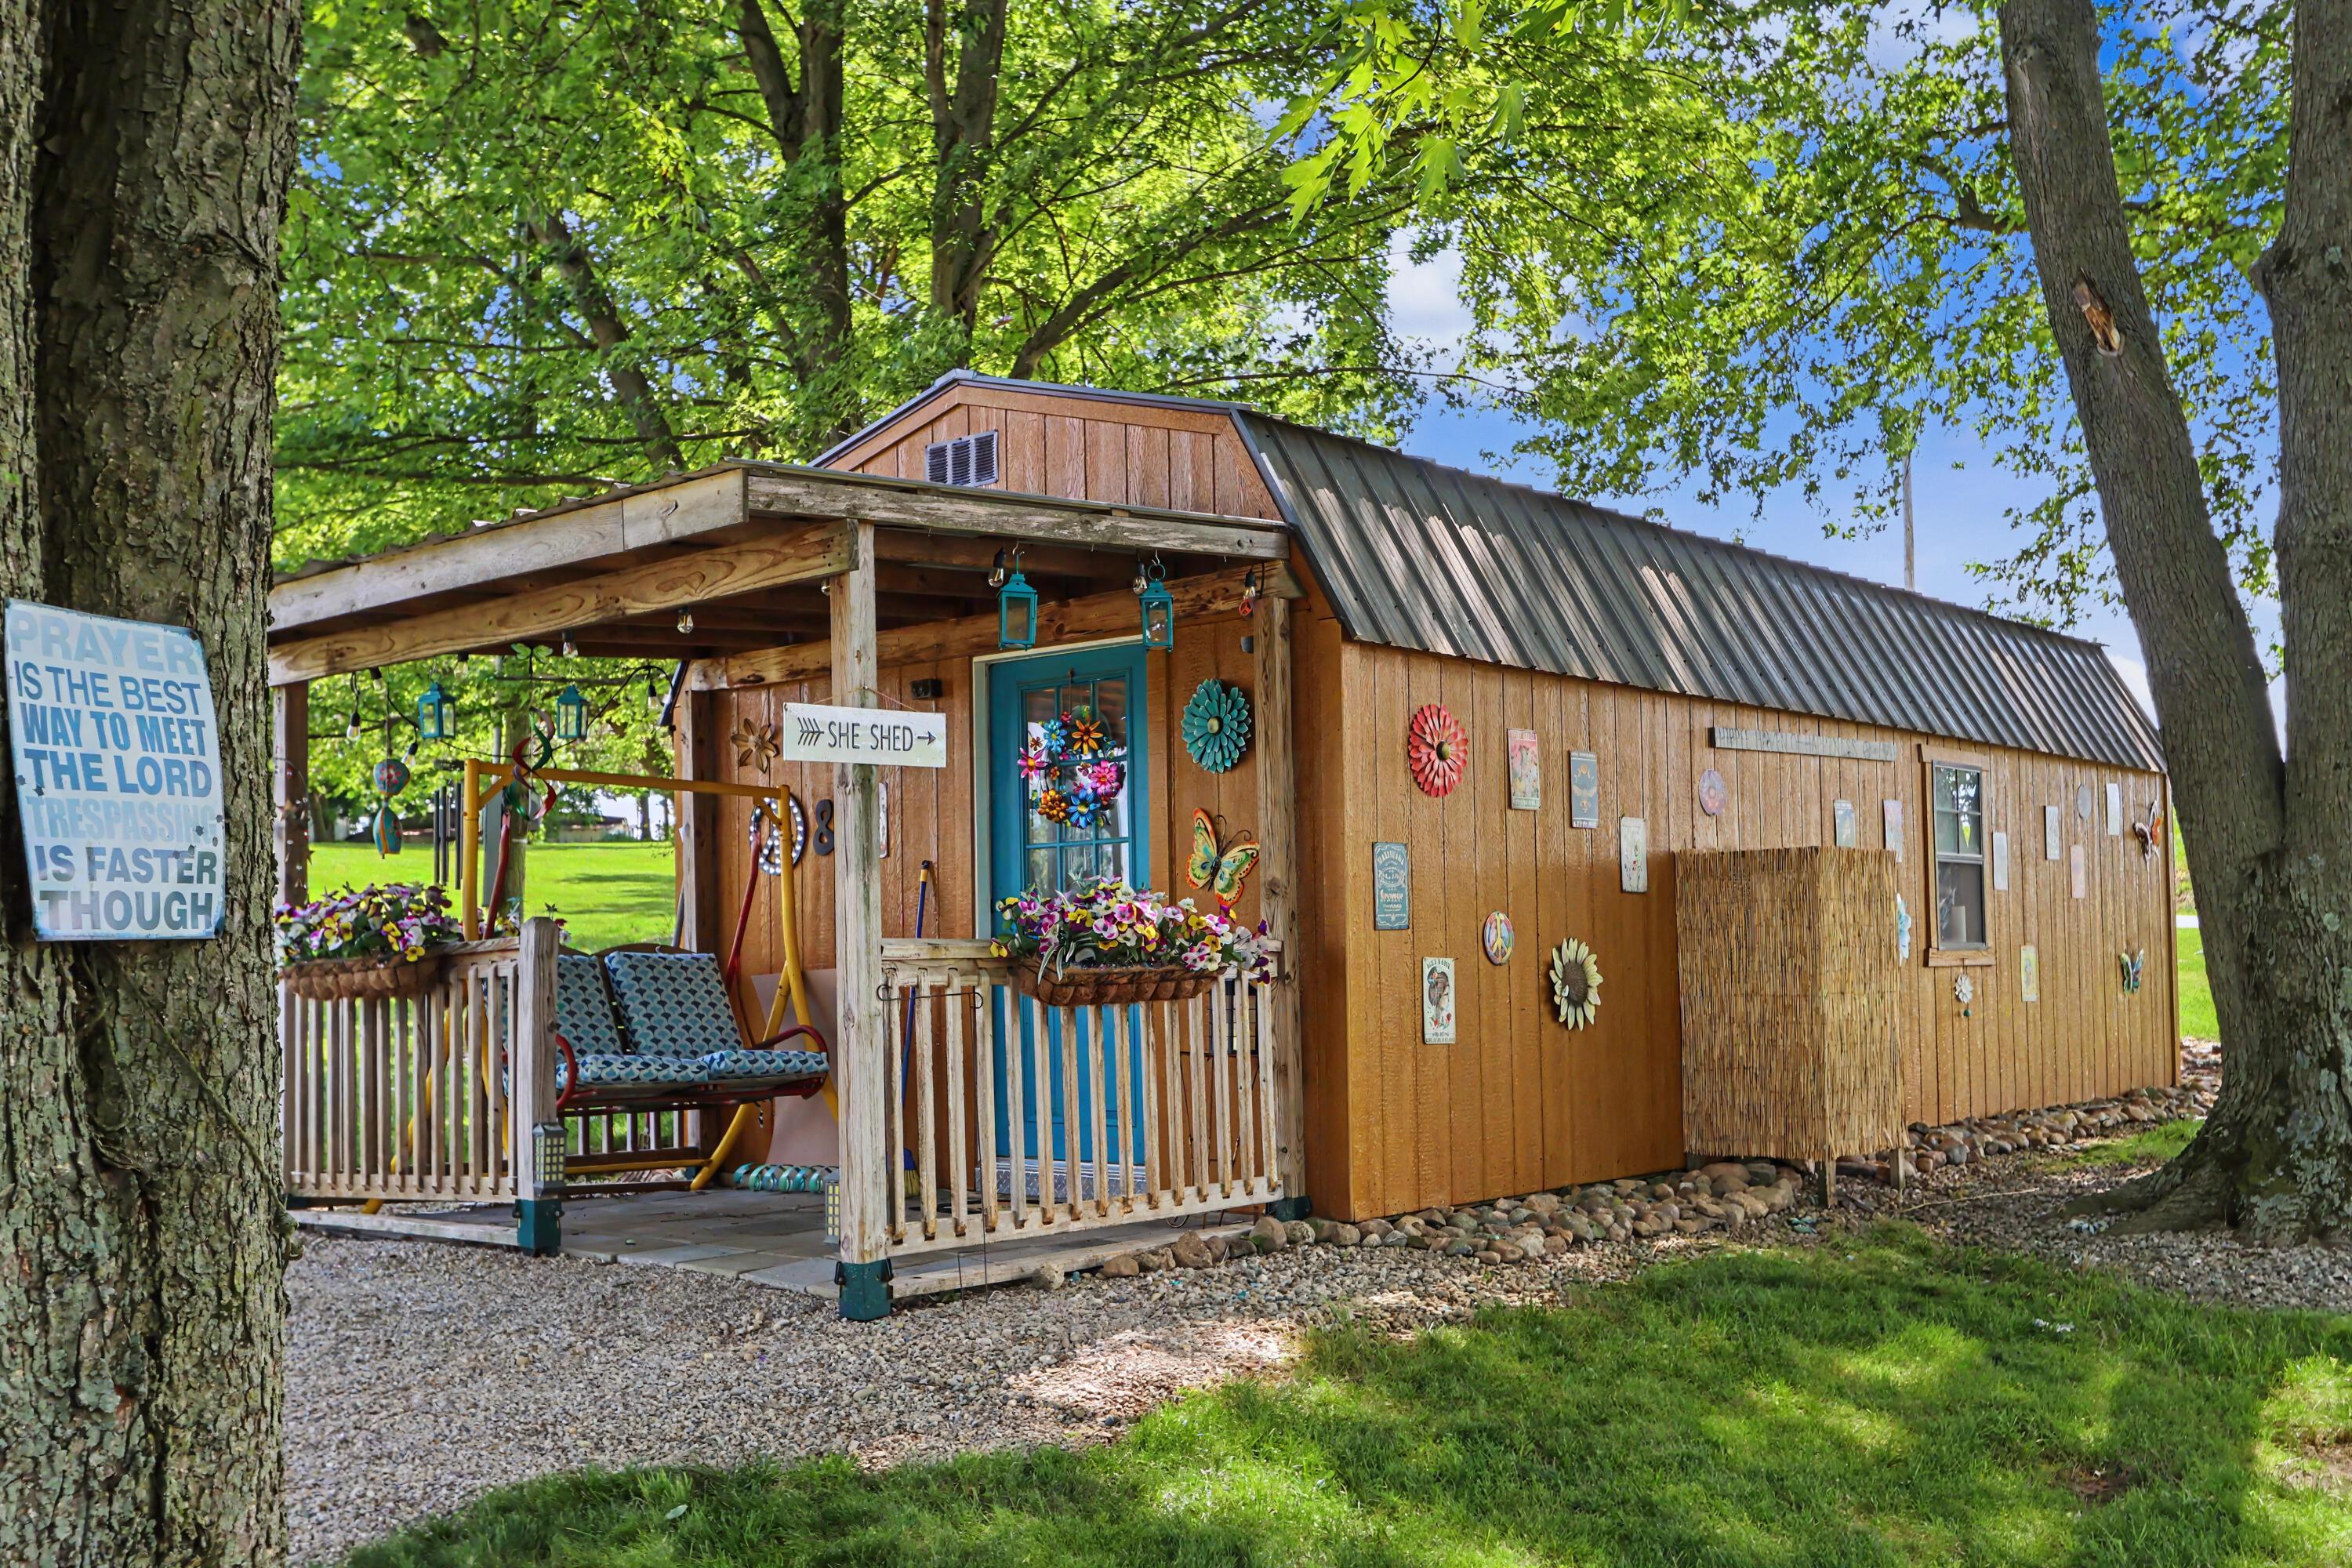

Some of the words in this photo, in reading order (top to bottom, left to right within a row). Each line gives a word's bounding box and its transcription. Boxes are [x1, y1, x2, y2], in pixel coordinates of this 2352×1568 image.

[9, 610, 199, 675] PRAYER
[14, 660, 42, 700] IS
[45, 666, 113, 708] THE
[119, 675, 201, 716] BEST
[20, 702, 82, 747] WAY
[90, 711, 131, 751] TO
[136, 715, 206, 757] MEET
[828, 720, 860, 749] SHE
[870, 724, 913, 751] SHED
[24, 748, 107, 792] THE
[114, 755, 212, 798] LORD
[26, 796, 216, 844] TRESPASSING
[34, 845, 74, 882] IS
[86, 846, 217, 884] FASTER
[39, 890, 212, 931] THOUGH
